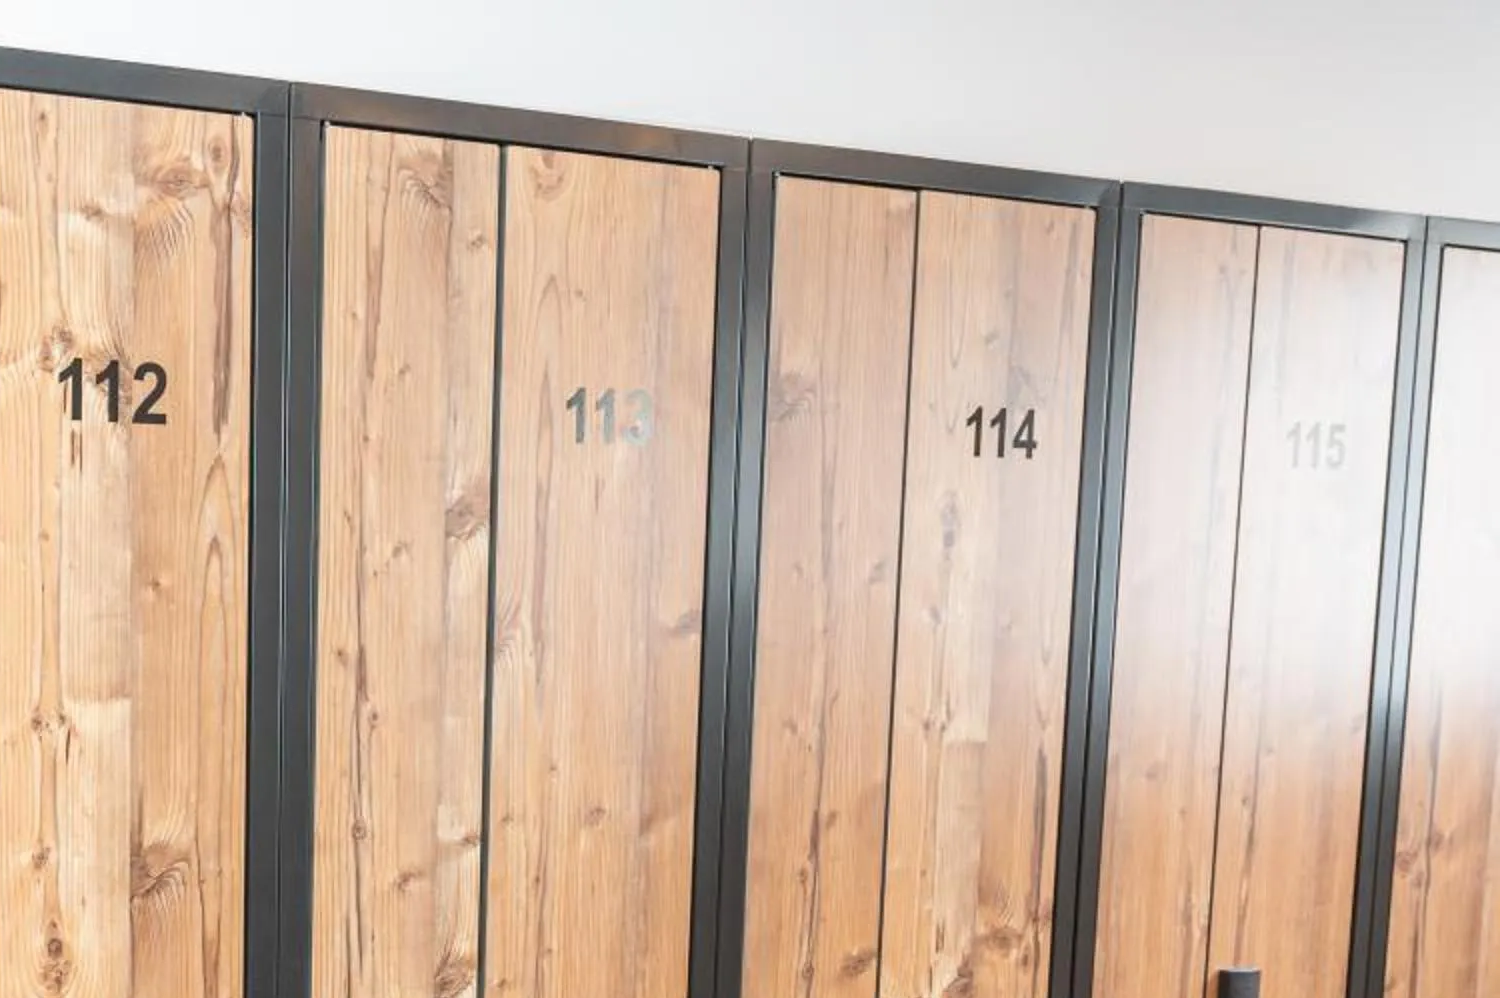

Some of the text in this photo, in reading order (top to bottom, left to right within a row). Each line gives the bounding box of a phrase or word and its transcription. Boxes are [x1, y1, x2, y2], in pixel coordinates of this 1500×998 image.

[57, 358, 167, 427] 112
[566, 386, 654, 447] 113
[966, 406, 1037, 460] 114
[1285, 421, 1347, 469] 115
